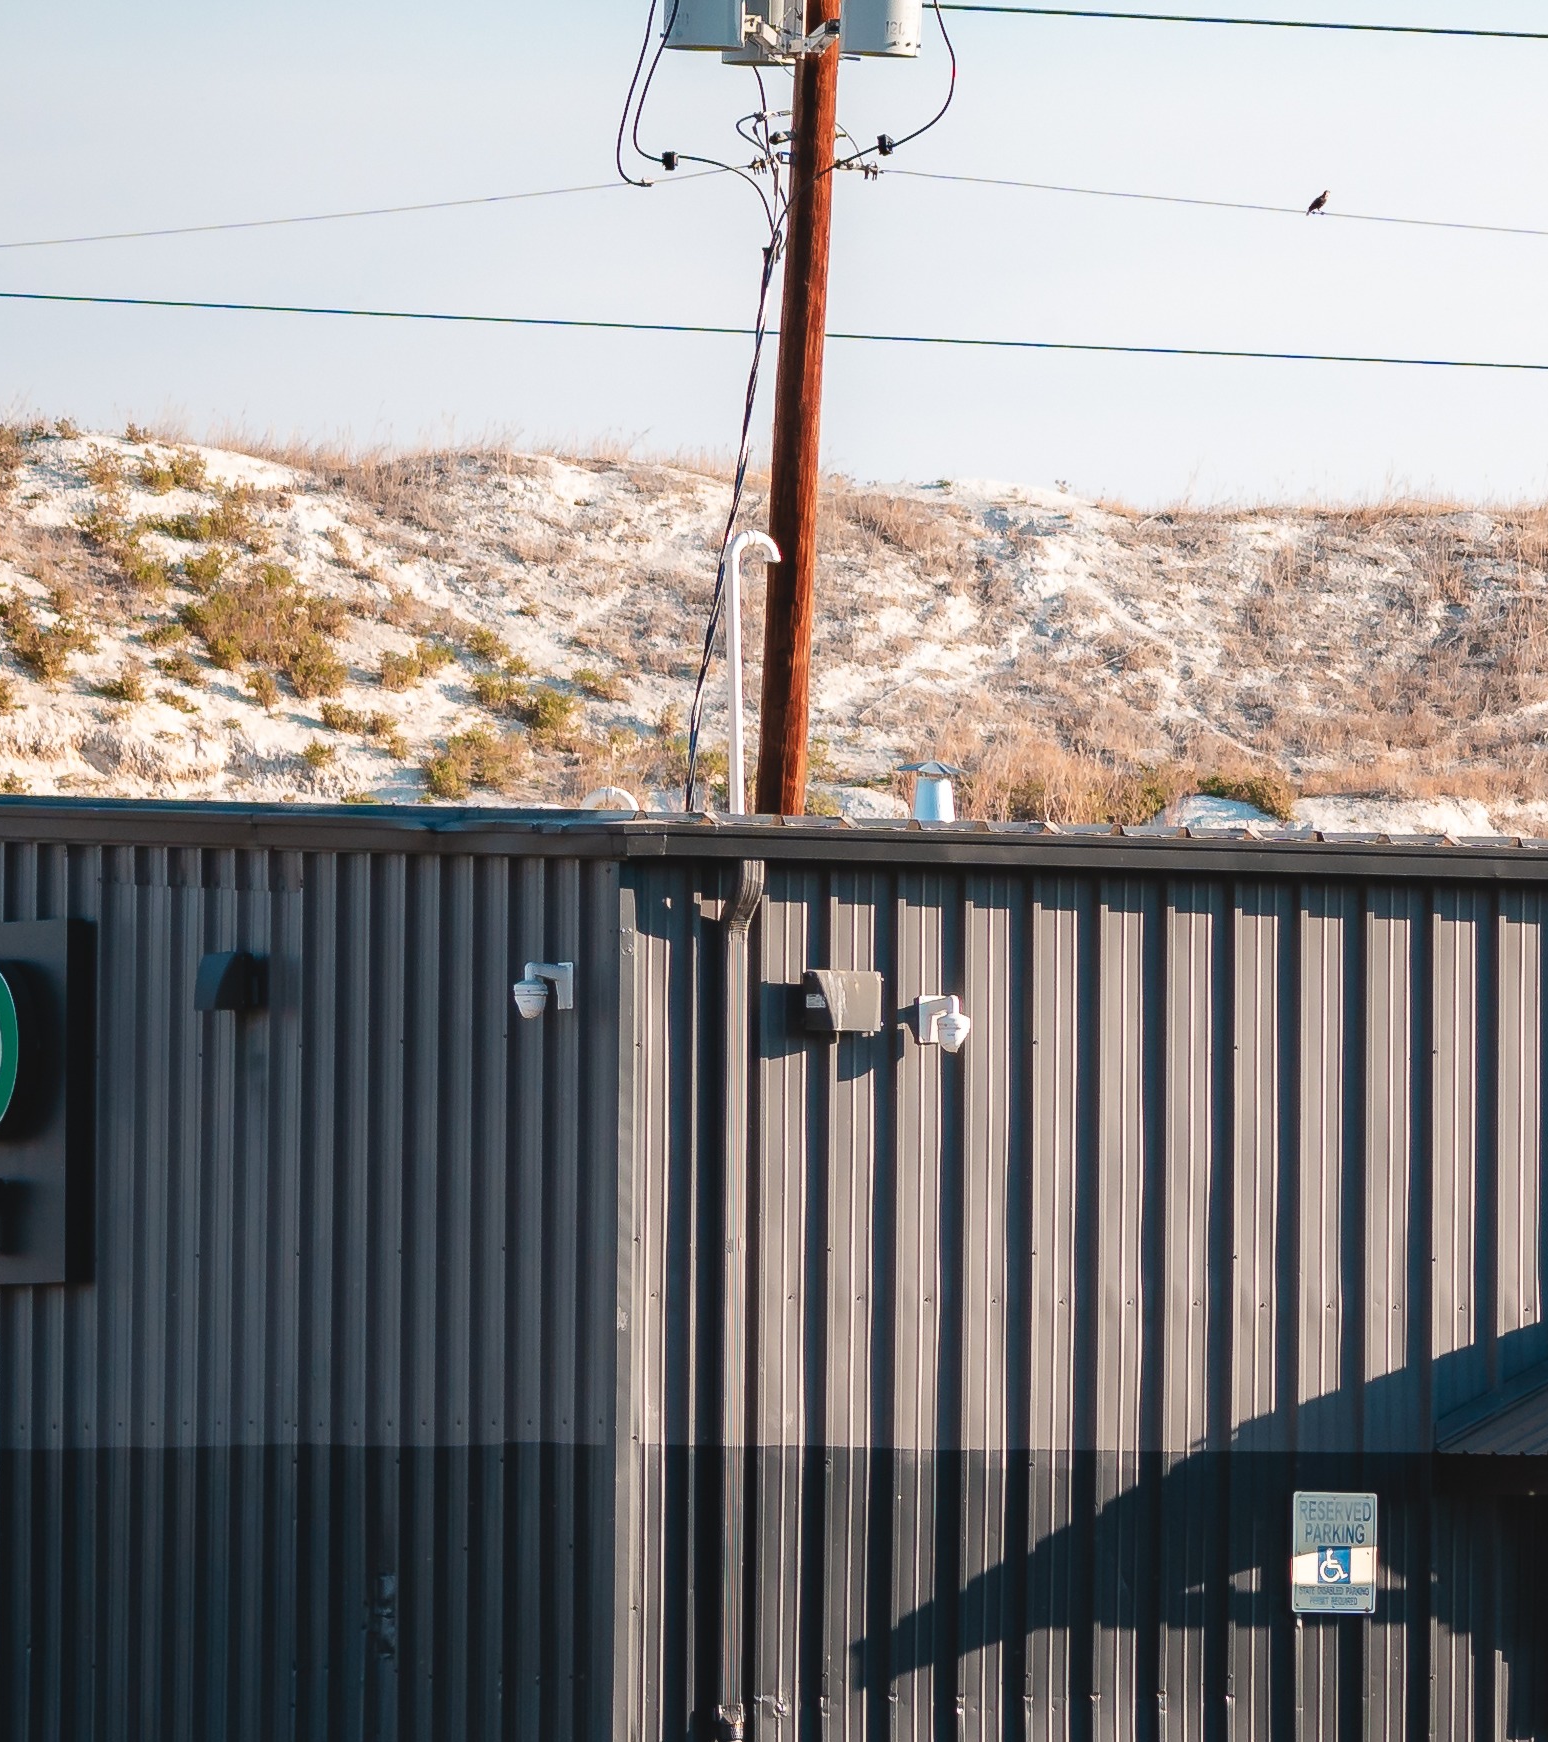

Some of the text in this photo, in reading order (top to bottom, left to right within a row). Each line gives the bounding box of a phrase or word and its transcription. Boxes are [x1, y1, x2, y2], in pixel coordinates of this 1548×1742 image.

[1299, 1500, 1372, 1522] RESERVED
[1305, 1522, 1366, 1545] PARKING
[1346, 1587, 1370, 1597] PARKING
